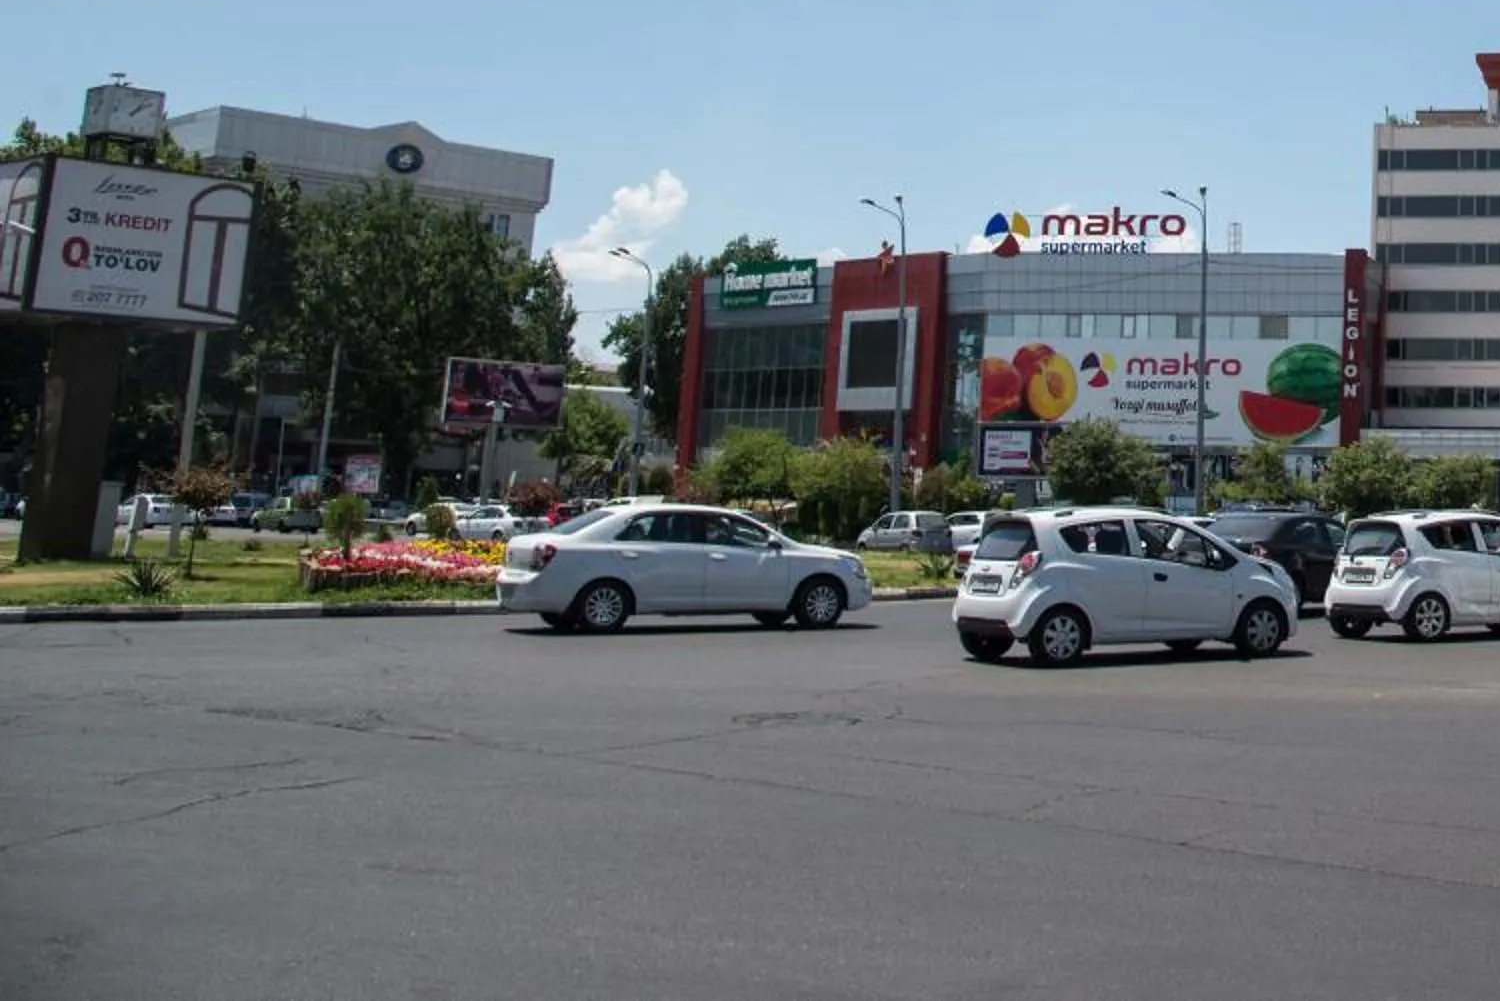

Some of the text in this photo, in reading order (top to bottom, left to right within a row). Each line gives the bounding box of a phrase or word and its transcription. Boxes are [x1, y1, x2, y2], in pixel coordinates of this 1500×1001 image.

[67, 207, 81, 224] 3
[105, 212, 172, 232] KREDIT
[1042, 206, 1186, 236] makro
[1041, 239, 1147, 255] supermarket
[1343, 289, 1360, 398] LEGION
[1126, 351, 1242, 376] makro
[1125, 378, 1212, 391] supermarkt
